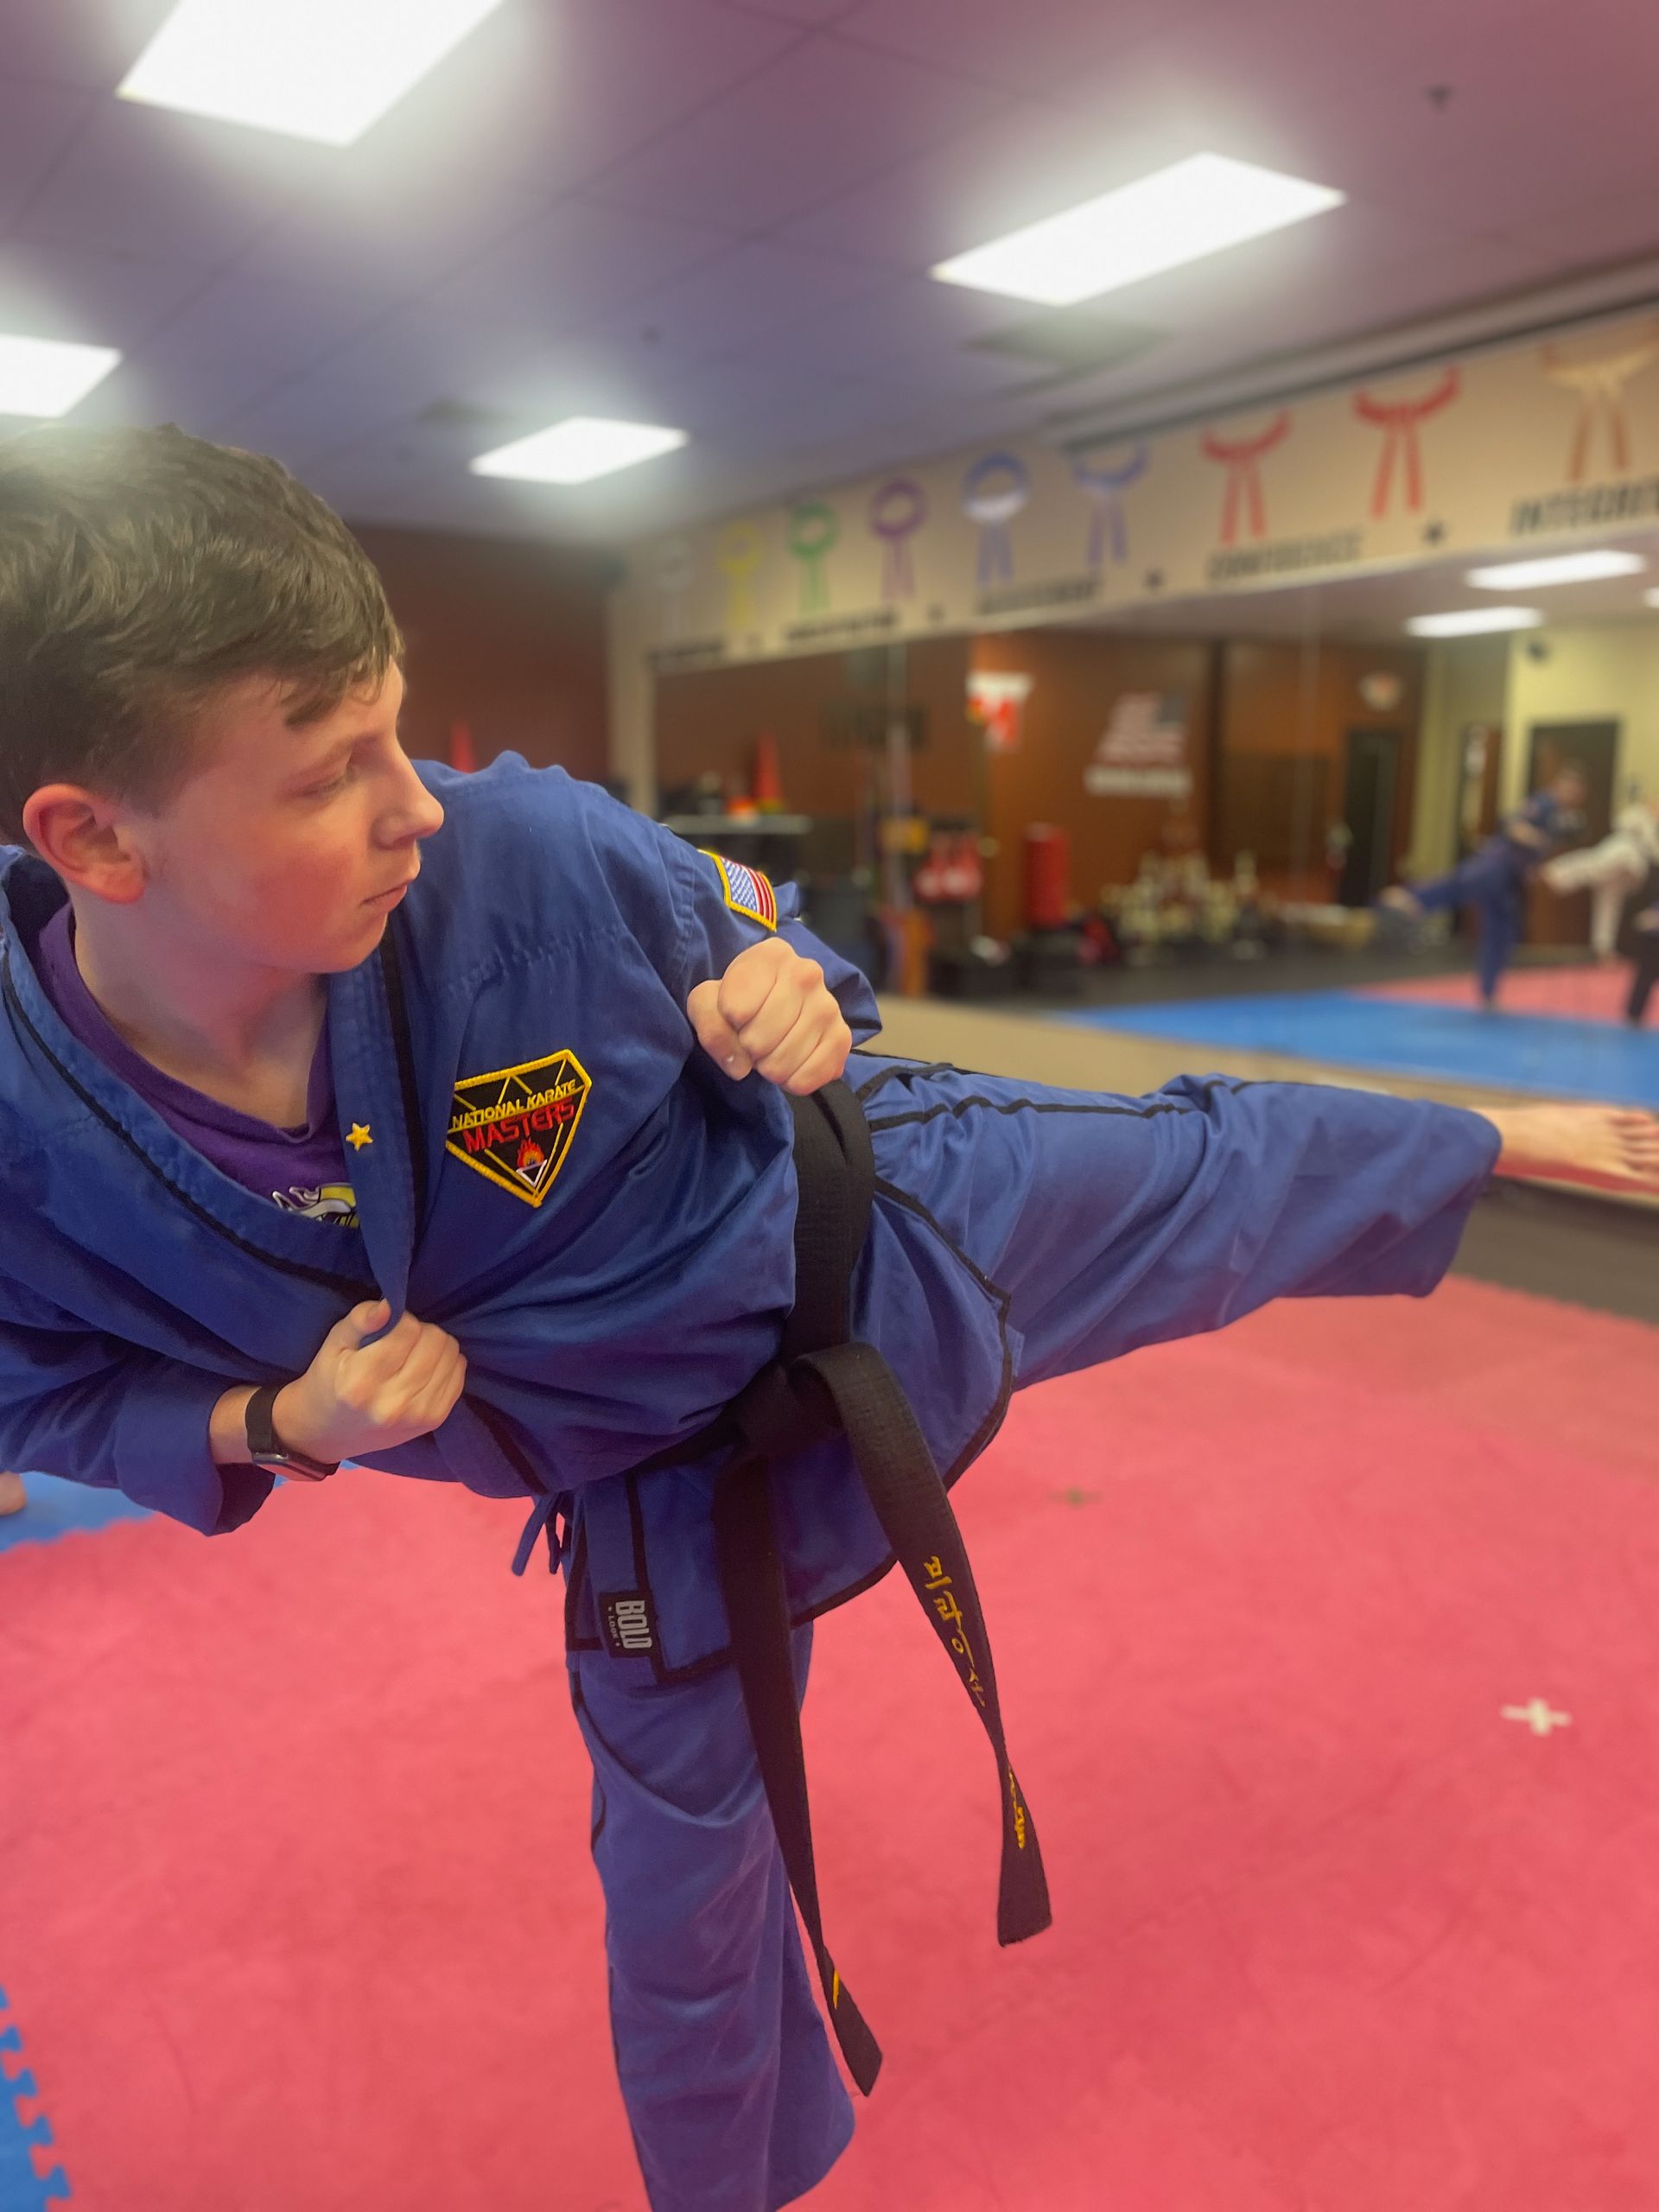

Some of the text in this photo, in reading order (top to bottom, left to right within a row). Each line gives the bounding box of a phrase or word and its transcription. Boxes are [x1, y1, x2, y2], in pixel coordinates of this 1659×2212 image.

[452, 1078, 576, 1128] NATIONAL KARATE
[462, 1096, 575, 1154] MASTERS
[615, 1600, 652, 1649] BOLD
